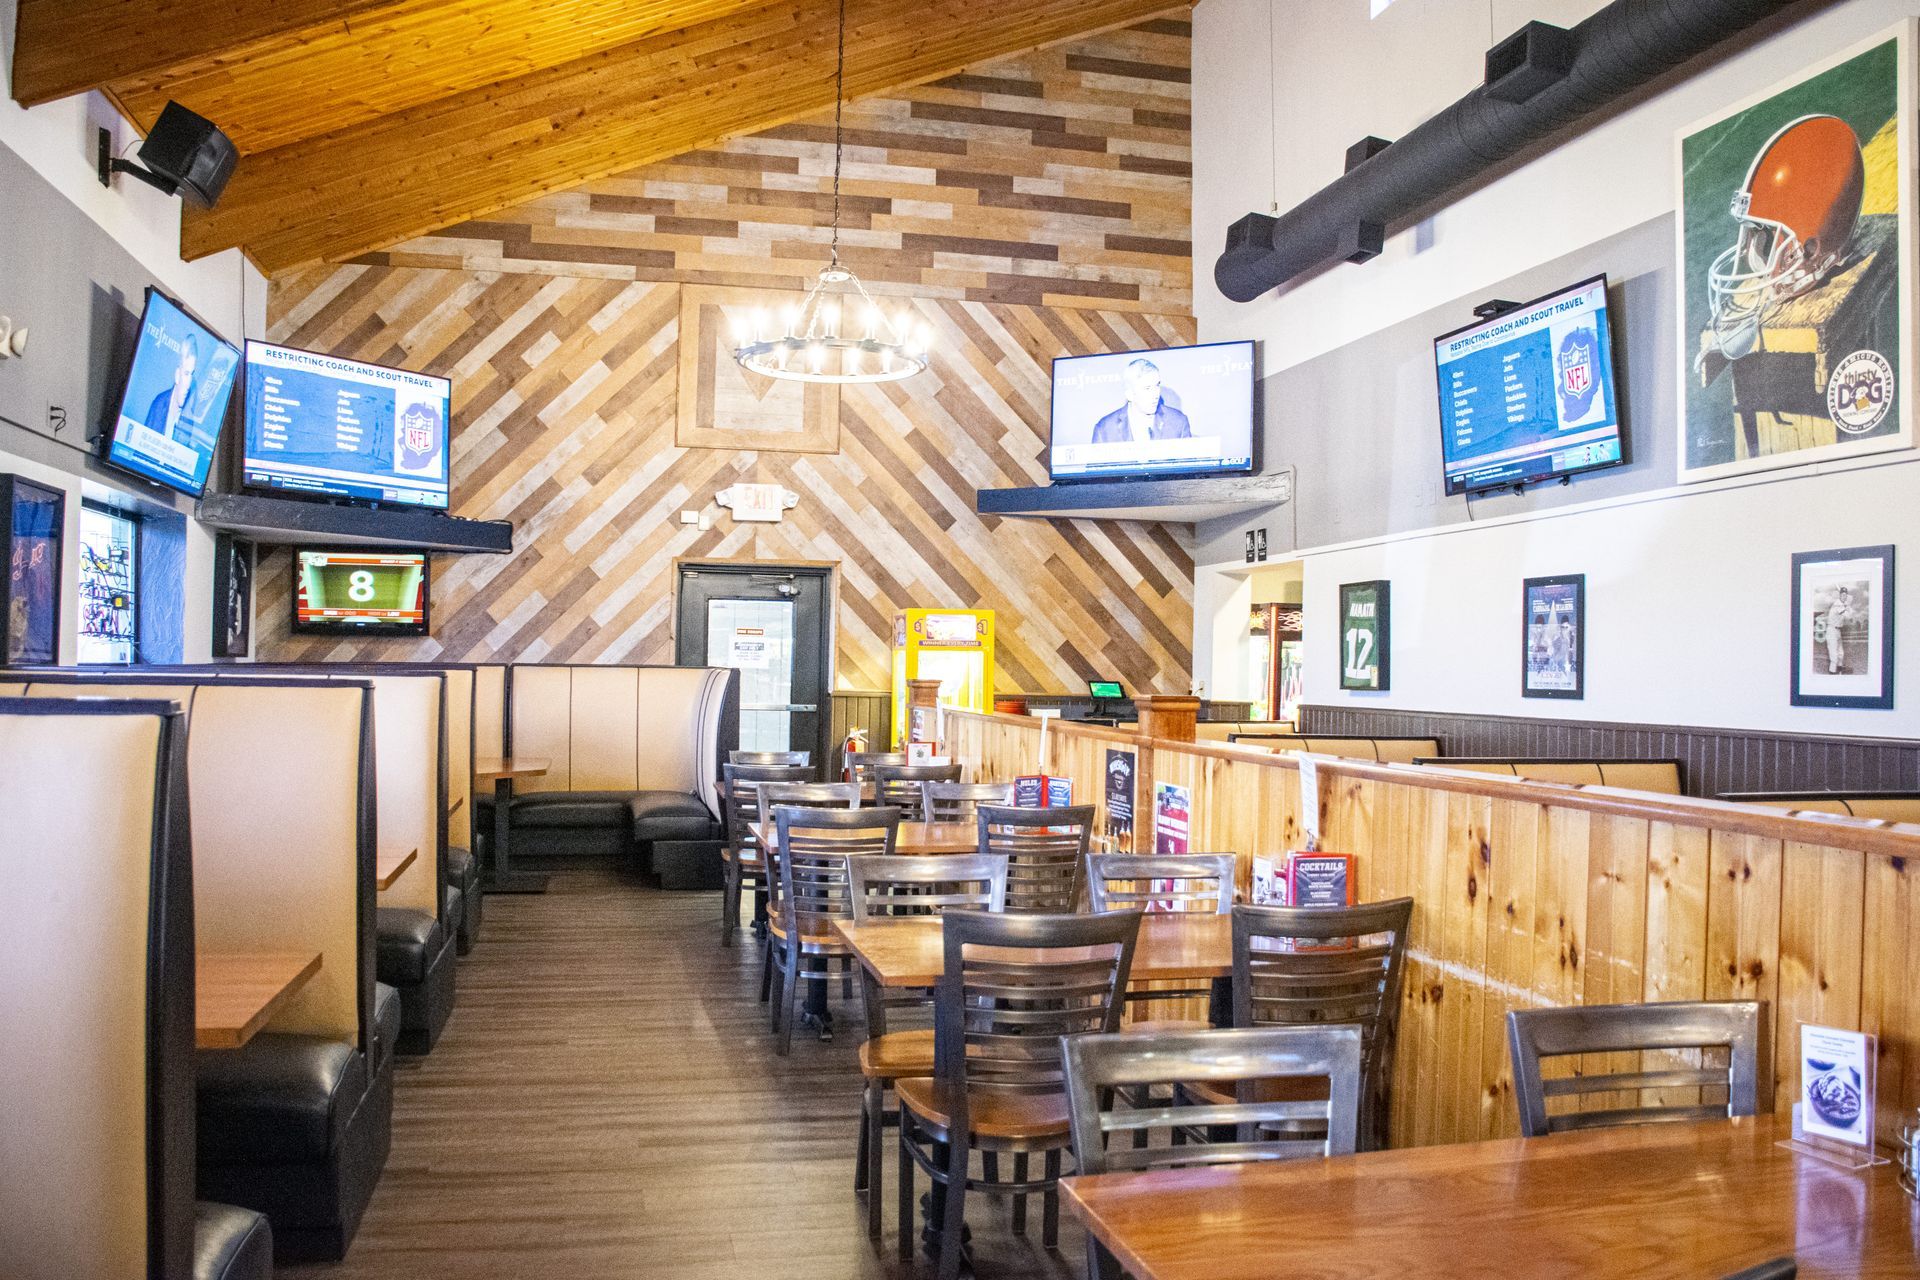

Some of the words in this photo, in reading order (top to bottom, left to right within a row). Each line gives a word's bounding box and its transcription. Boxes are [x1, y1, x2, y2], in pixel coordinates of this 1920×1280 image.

[148, 322, 159, 339] THE
[1450, 331, 1490, 352] RESTRICTING
[1490, 322, 1514, 337] COACH
[1514, 316, 1529, 328] AND
[1530, 307, 1553, 322] SCOUT
[1554, 296, 1583, 314] TRAVEL
[265, 348, 324, 367] RESTRICTING
[325, 360, 354, 373] COACH
[356, 366, 373, 376] AND
[375, 370, 401, 382] SCOUT
[403, 375, 432, 388] TRAVEL
[1200, 364, 1222, 376] THE
[1565, 363, 1588, 391] NFL
[1844, 368, 1877, 384] thirsty
[1057, 376, 1078, 386] THE
[1838, 377, 1883, 410] DOG
[409, 429, 429, 447] NFL
[744, 486, 774, 510] EXIT
[348, 570, 375, 602] 8
[1350, 603, 1375, 617] NAMATH
[1345, 628, 1373, 679] 12
[1299, 862, 1343, 871] COCKTAILS
